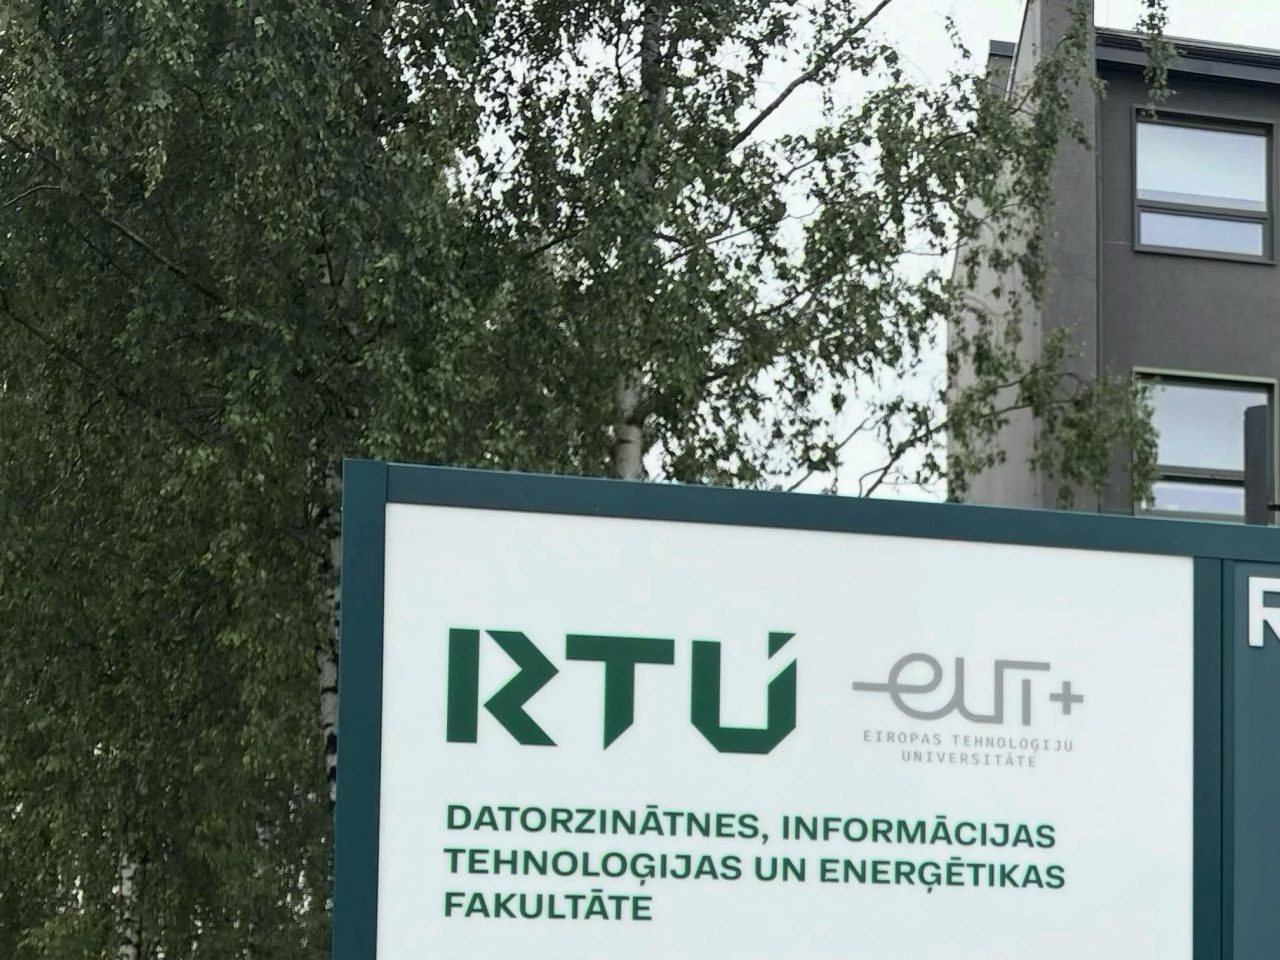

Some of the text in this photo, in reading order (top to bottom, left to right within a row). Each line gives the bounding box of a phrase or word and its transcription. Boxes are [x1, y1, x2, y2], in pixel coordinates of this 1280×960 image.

[863, 730, 1073, 753] EIROPAS TEHNOLOĢIJU
[901, 750, 1036, 768] UNIVERSITĀTE
[446, 804, 1057, 850] DATORZINĀTNES, INFORMĀCIJAS
[443, 848, 1066, 895] TEHNOLOĢIJAS UN ENERĢĒTIKAS
[444, 888, 653, 922] FAKULTĀTE
